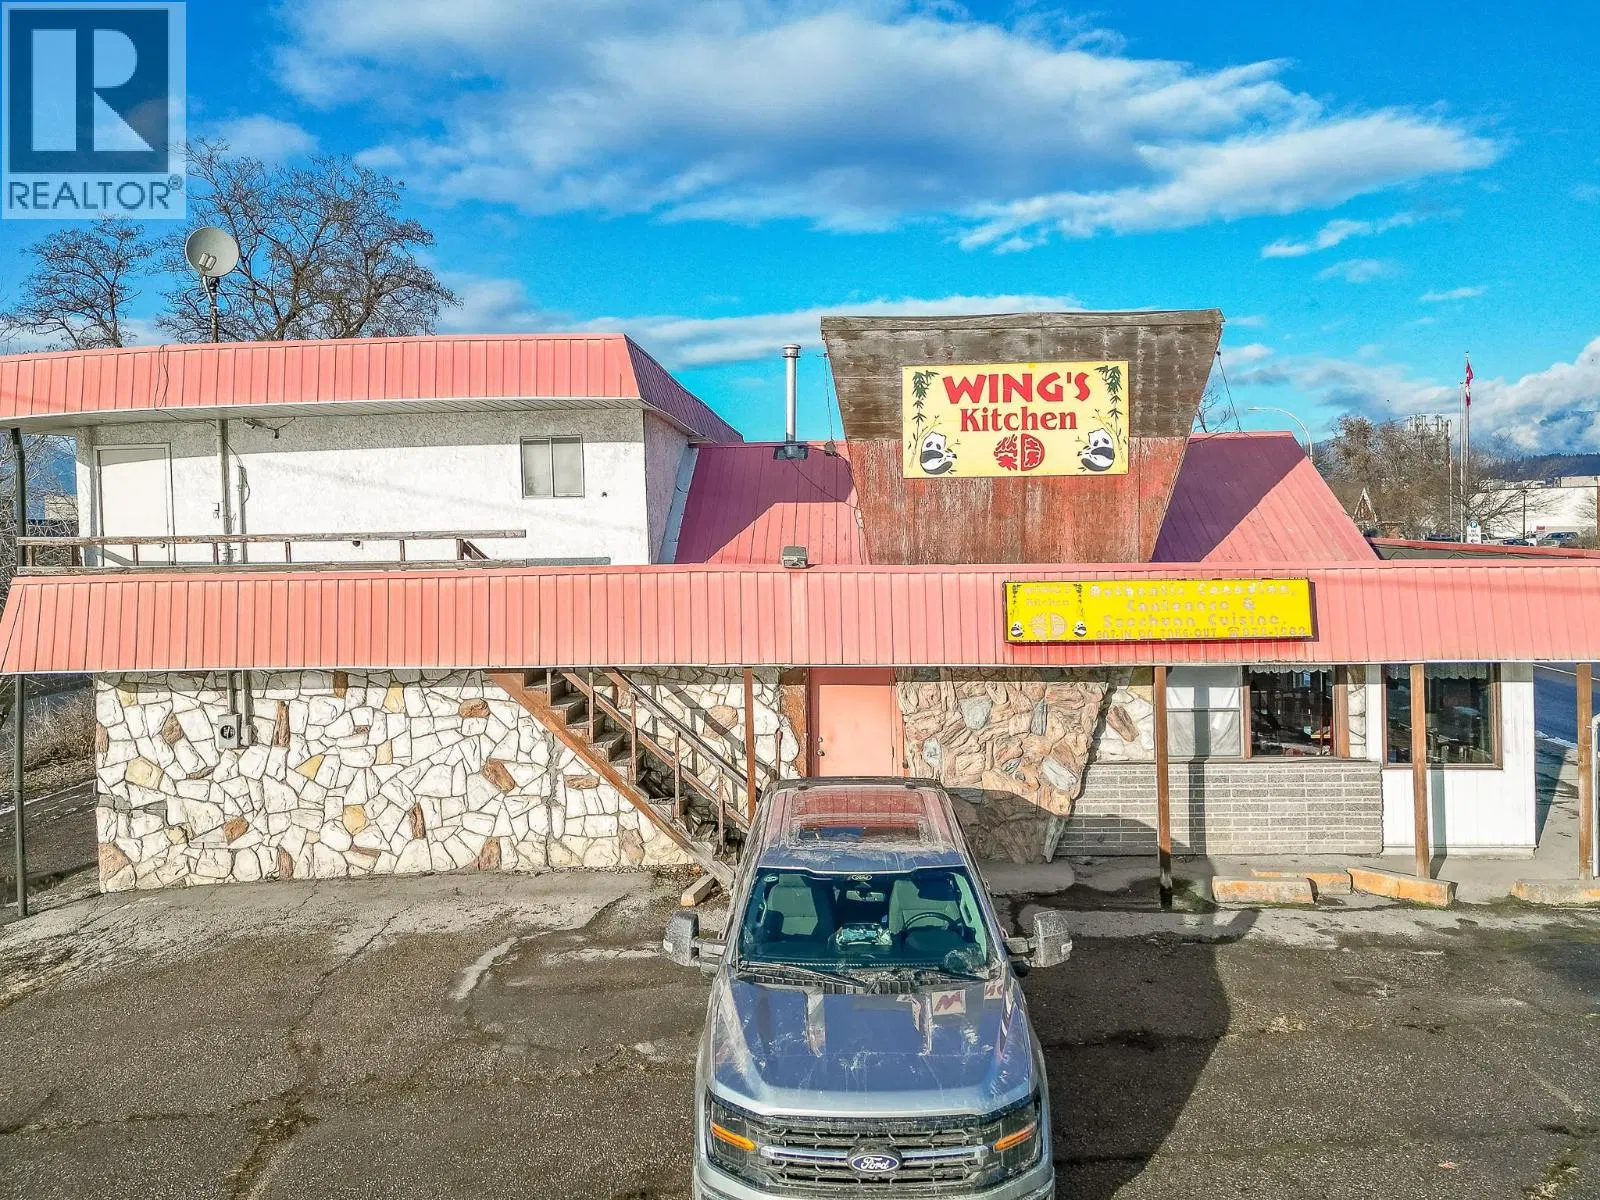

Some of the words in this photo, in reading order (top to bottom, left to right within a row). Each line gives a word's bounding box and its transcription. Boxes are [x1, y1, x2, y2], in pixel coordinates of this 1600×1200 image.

[942, 372, 1091, 404] WING'S
[960, 406, 1078, 432] Kitchen
[1090, 585, 1185, 597] Authentic
[1127, 599, 1230, 612] Cantonese
[1243, 597, 1255, 610] &
[1103, 614, 1196, 628] Szechuan
[860, 1156, 890, 1169] Ford
